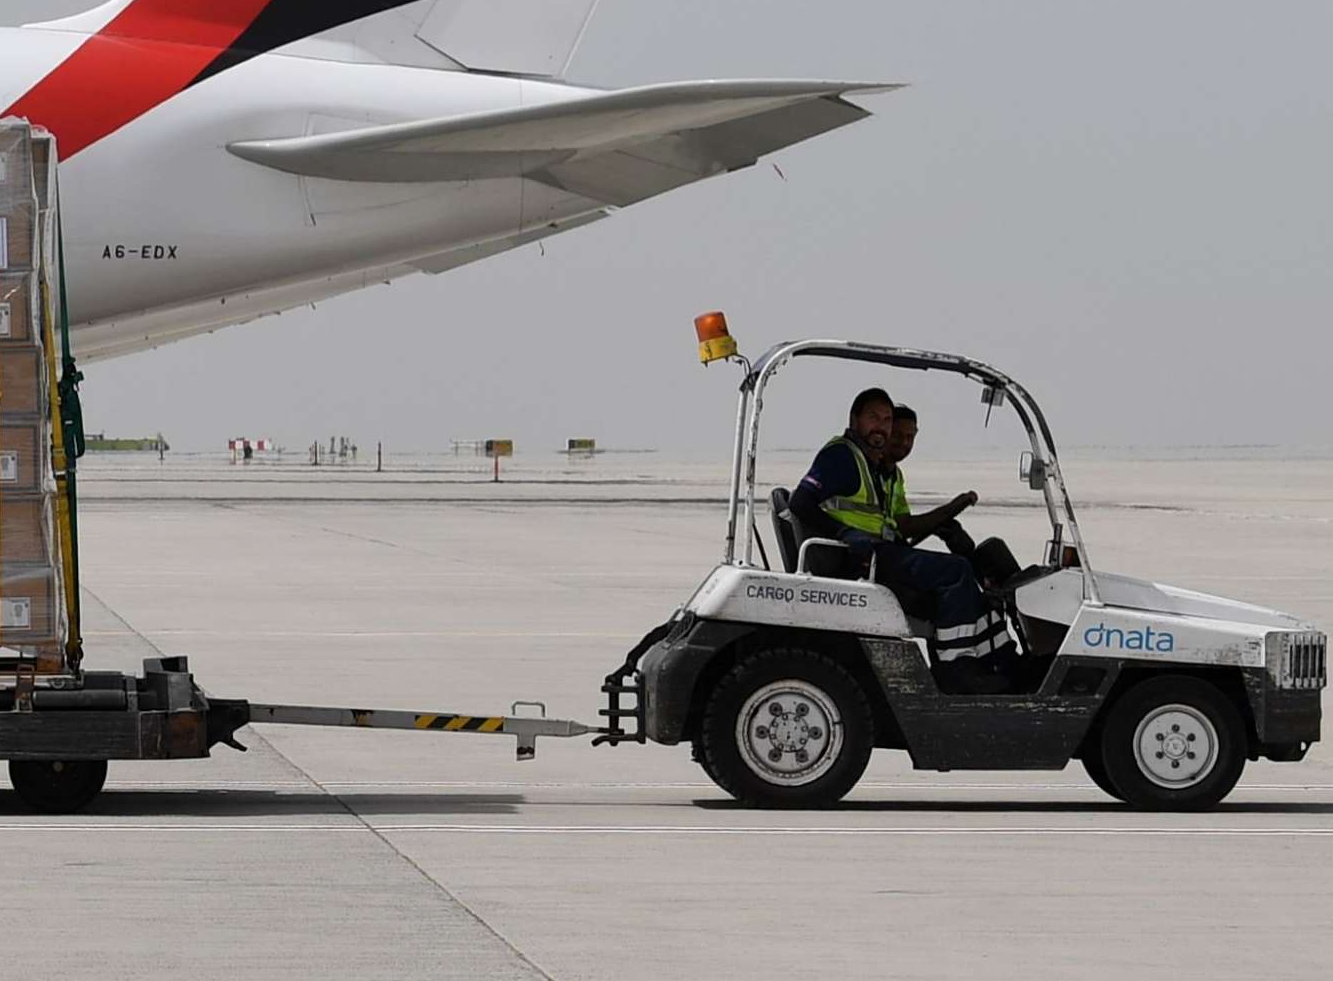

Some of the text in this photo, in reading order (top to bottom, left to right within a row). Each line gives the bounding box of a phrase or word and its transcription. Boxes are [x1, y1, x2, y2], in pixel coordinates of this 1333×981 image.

[102, 245, 178, 260] A6-EDX
[746, 585, 868, 608] CARGO SERVICES
[1084, 623, 1174, 652] dnata
